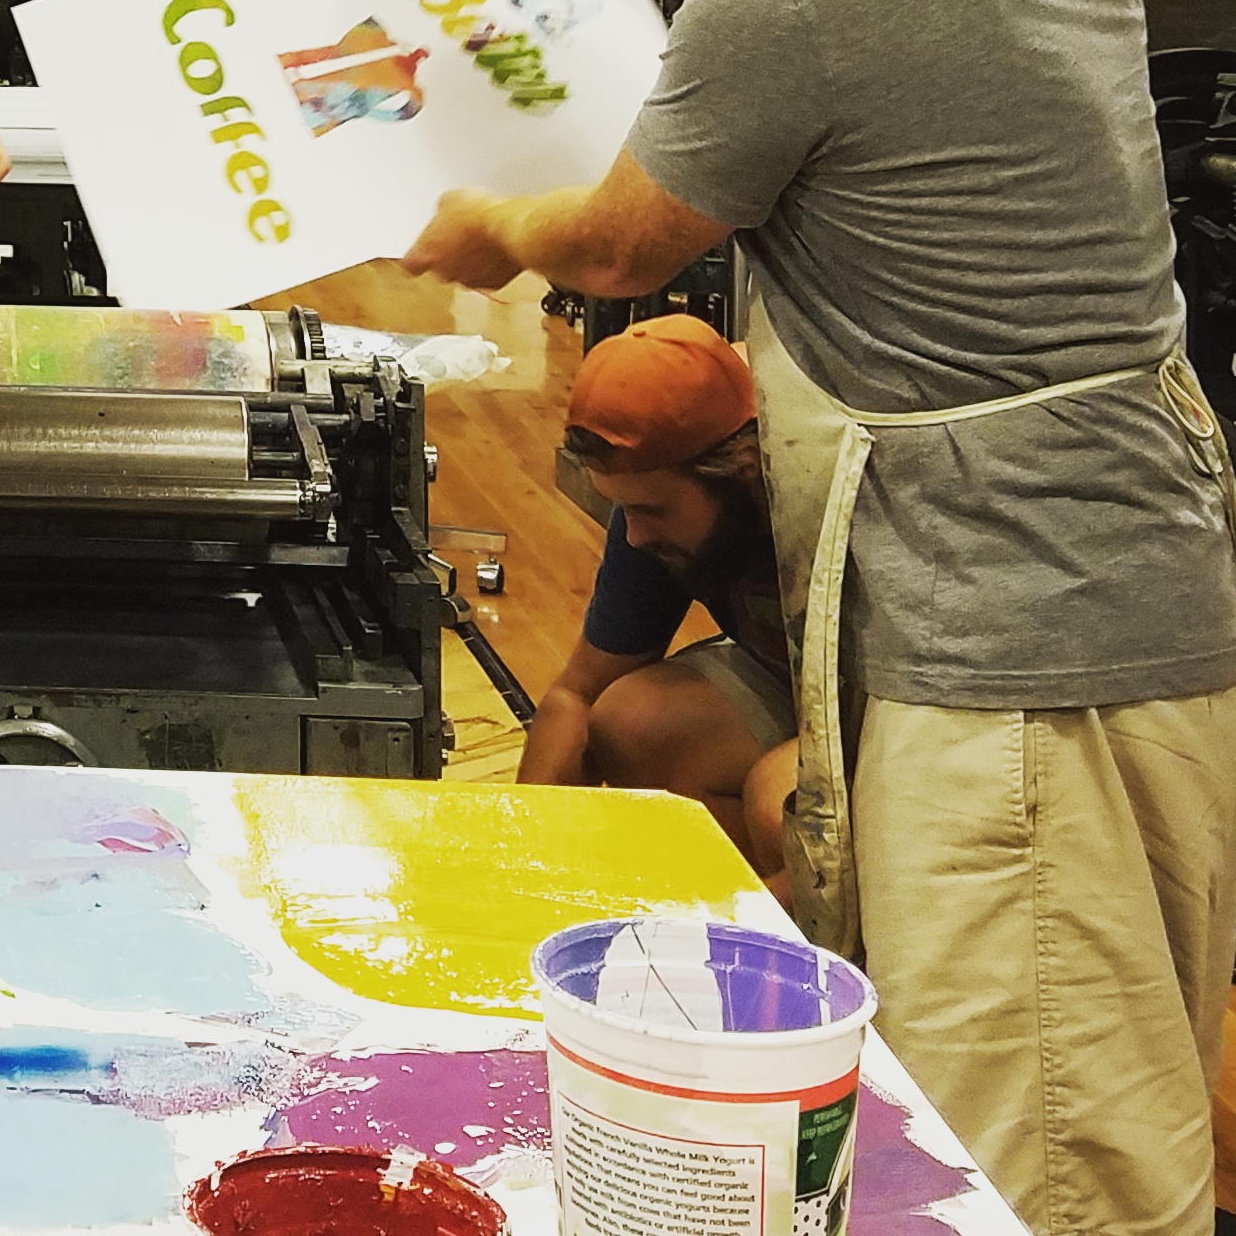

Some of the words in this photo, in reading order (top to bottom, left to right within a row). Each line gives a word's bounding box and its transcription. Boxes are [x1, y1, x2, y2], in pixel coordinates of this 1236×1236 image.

[606, 1145, 641, 1163] carefully
[642, 1157, 680, 1171] selected
[682, 1164, 736, 1177] ingredients
[623, 1137, 653, 1153] Vanilla
[655, 1146, 686, 1159] Whole
[689, 1152, 709, 1162] Milk
[712, 1155, 746, 1166] Yogurt
[749, 1157, 755, 1165] is
[602, 1156, 646, 1175] accordance
[649, 1170, 670, 1180] with
[671, 1176, 712, 1188] certified
[714, 1182, 749, 1191] organic
[614, 1172, 641, 1186] means
[642, 1181, 659, 1193] you
[661, 1187, 677, 1195] can
[680, 1189, 698, 1198] feel
[700, 1193, 725, 1202] good
[728, 1194, 755, 1203] about
[603, 1179, 638, 1198] delicious
[640, 1193, 673, 1207] organic
[675, 1202, 710, 1212] yogurts
[712, 1205, 750, 1215] because
[654, 1222, 664, 1230] or
[666, 1225, 705, 1236] artificial
[662, 1210, 681, 1221] that
[684, 1214, 707, 1225] have
[709, 1218, 725, 1227] not
[728, 1218, 751, 1227] been
